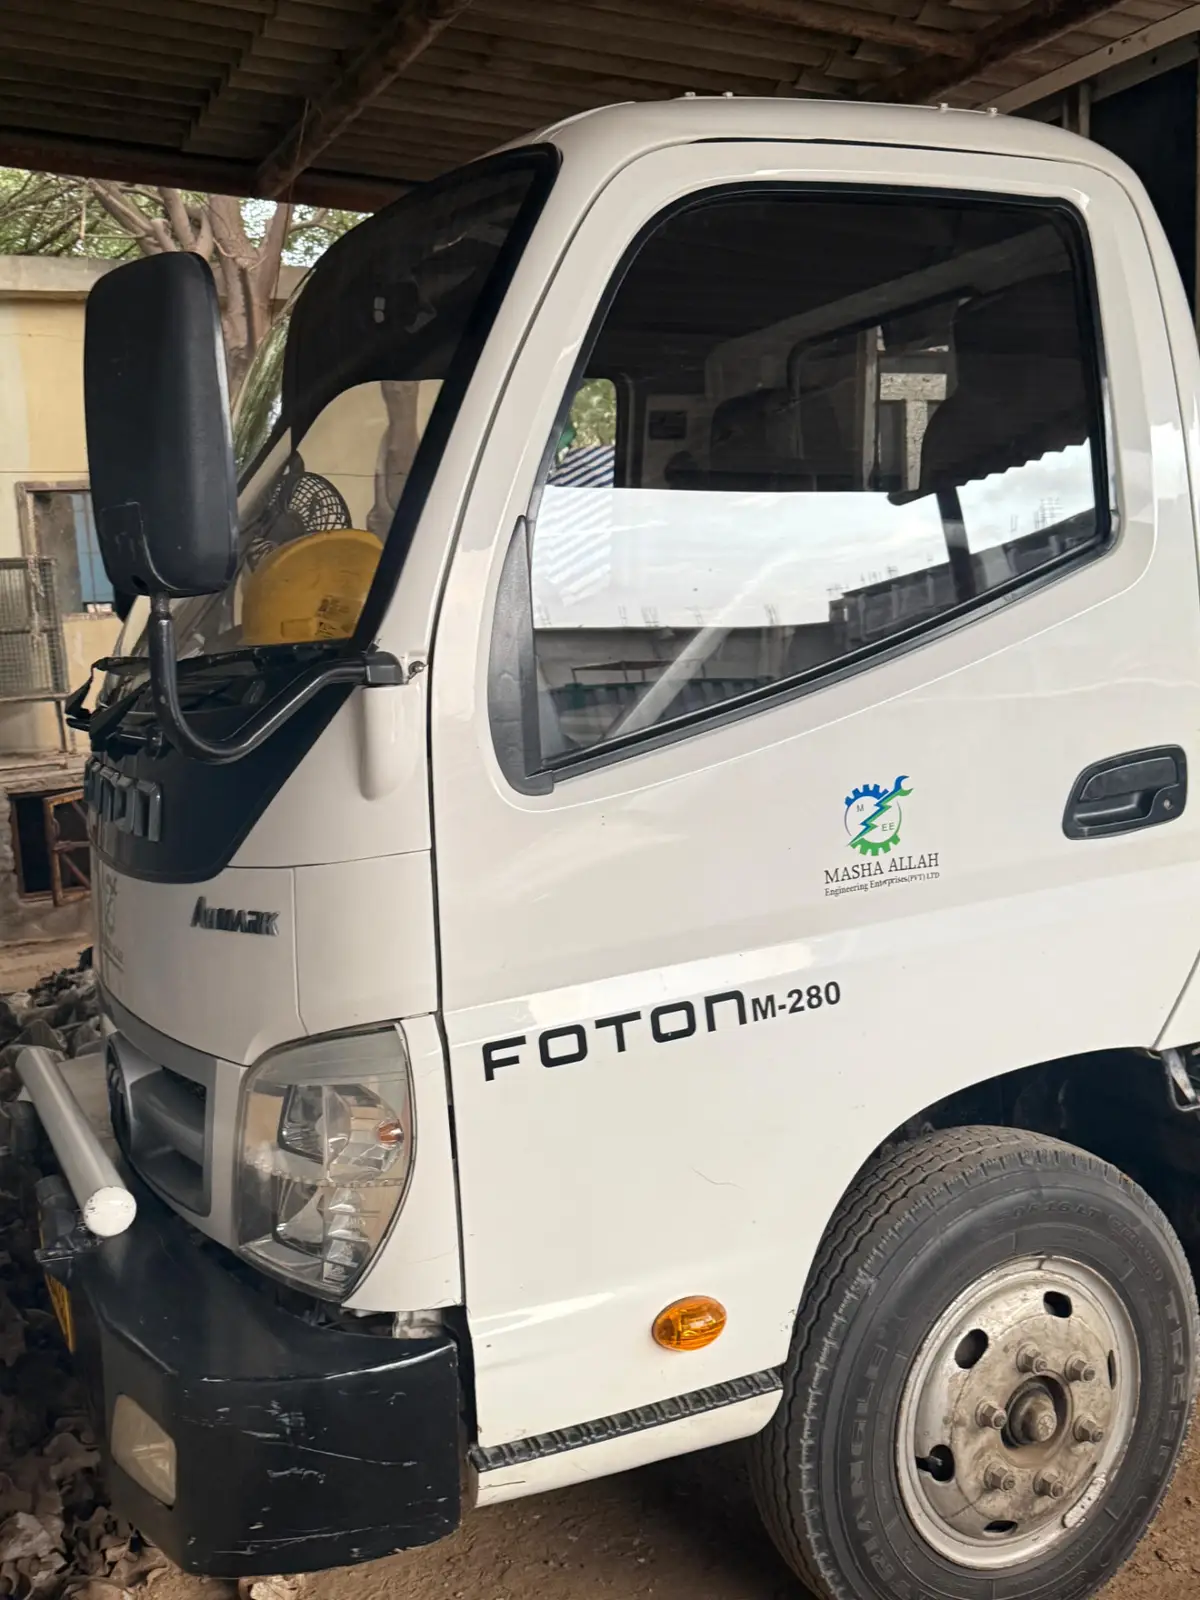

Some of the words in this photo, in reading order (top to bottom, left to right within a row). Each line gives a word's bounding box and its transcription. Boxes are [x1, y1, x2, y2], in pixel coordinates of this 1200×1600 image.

[856, 804, 865, 812] M
[824, 861, 884, 884] MASHA
[888, 852, 940, 872] ALLAH
[824, 883, 869, 897] Engineering
[926, 871, 940, 880] LTD
[482, 990, 747, 1081] FOTON
[751, 981, 841, 1021] M-280
